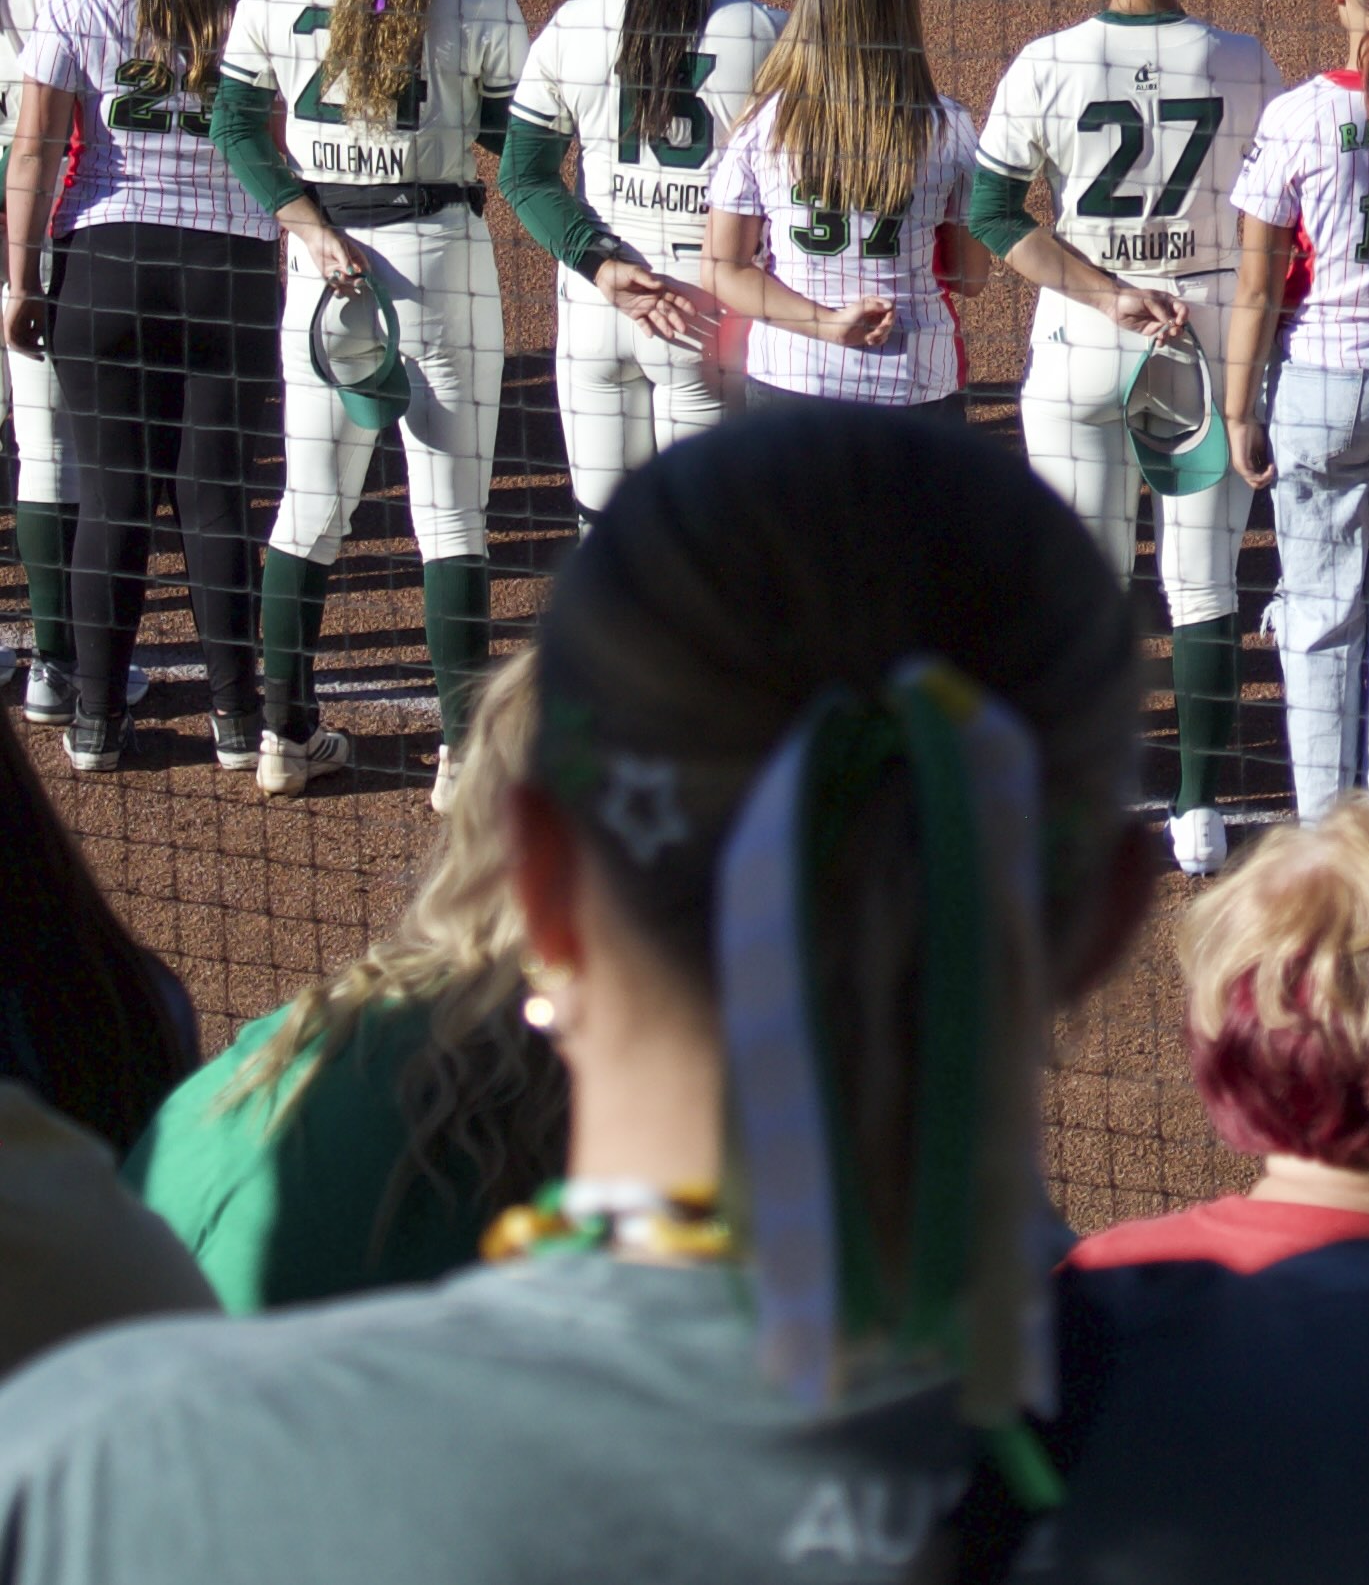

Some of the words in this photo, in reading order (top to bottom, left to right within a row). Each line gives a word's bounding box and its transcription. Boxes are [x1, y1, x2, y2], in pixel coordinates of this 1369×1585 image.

[312, 140, 404, 176] COLEMAN
[1077, 97, 1224, 218] 27
[612, 174, 710, 214] PALACIOS
[1101, 230, 1196, 263] JAQUISH
